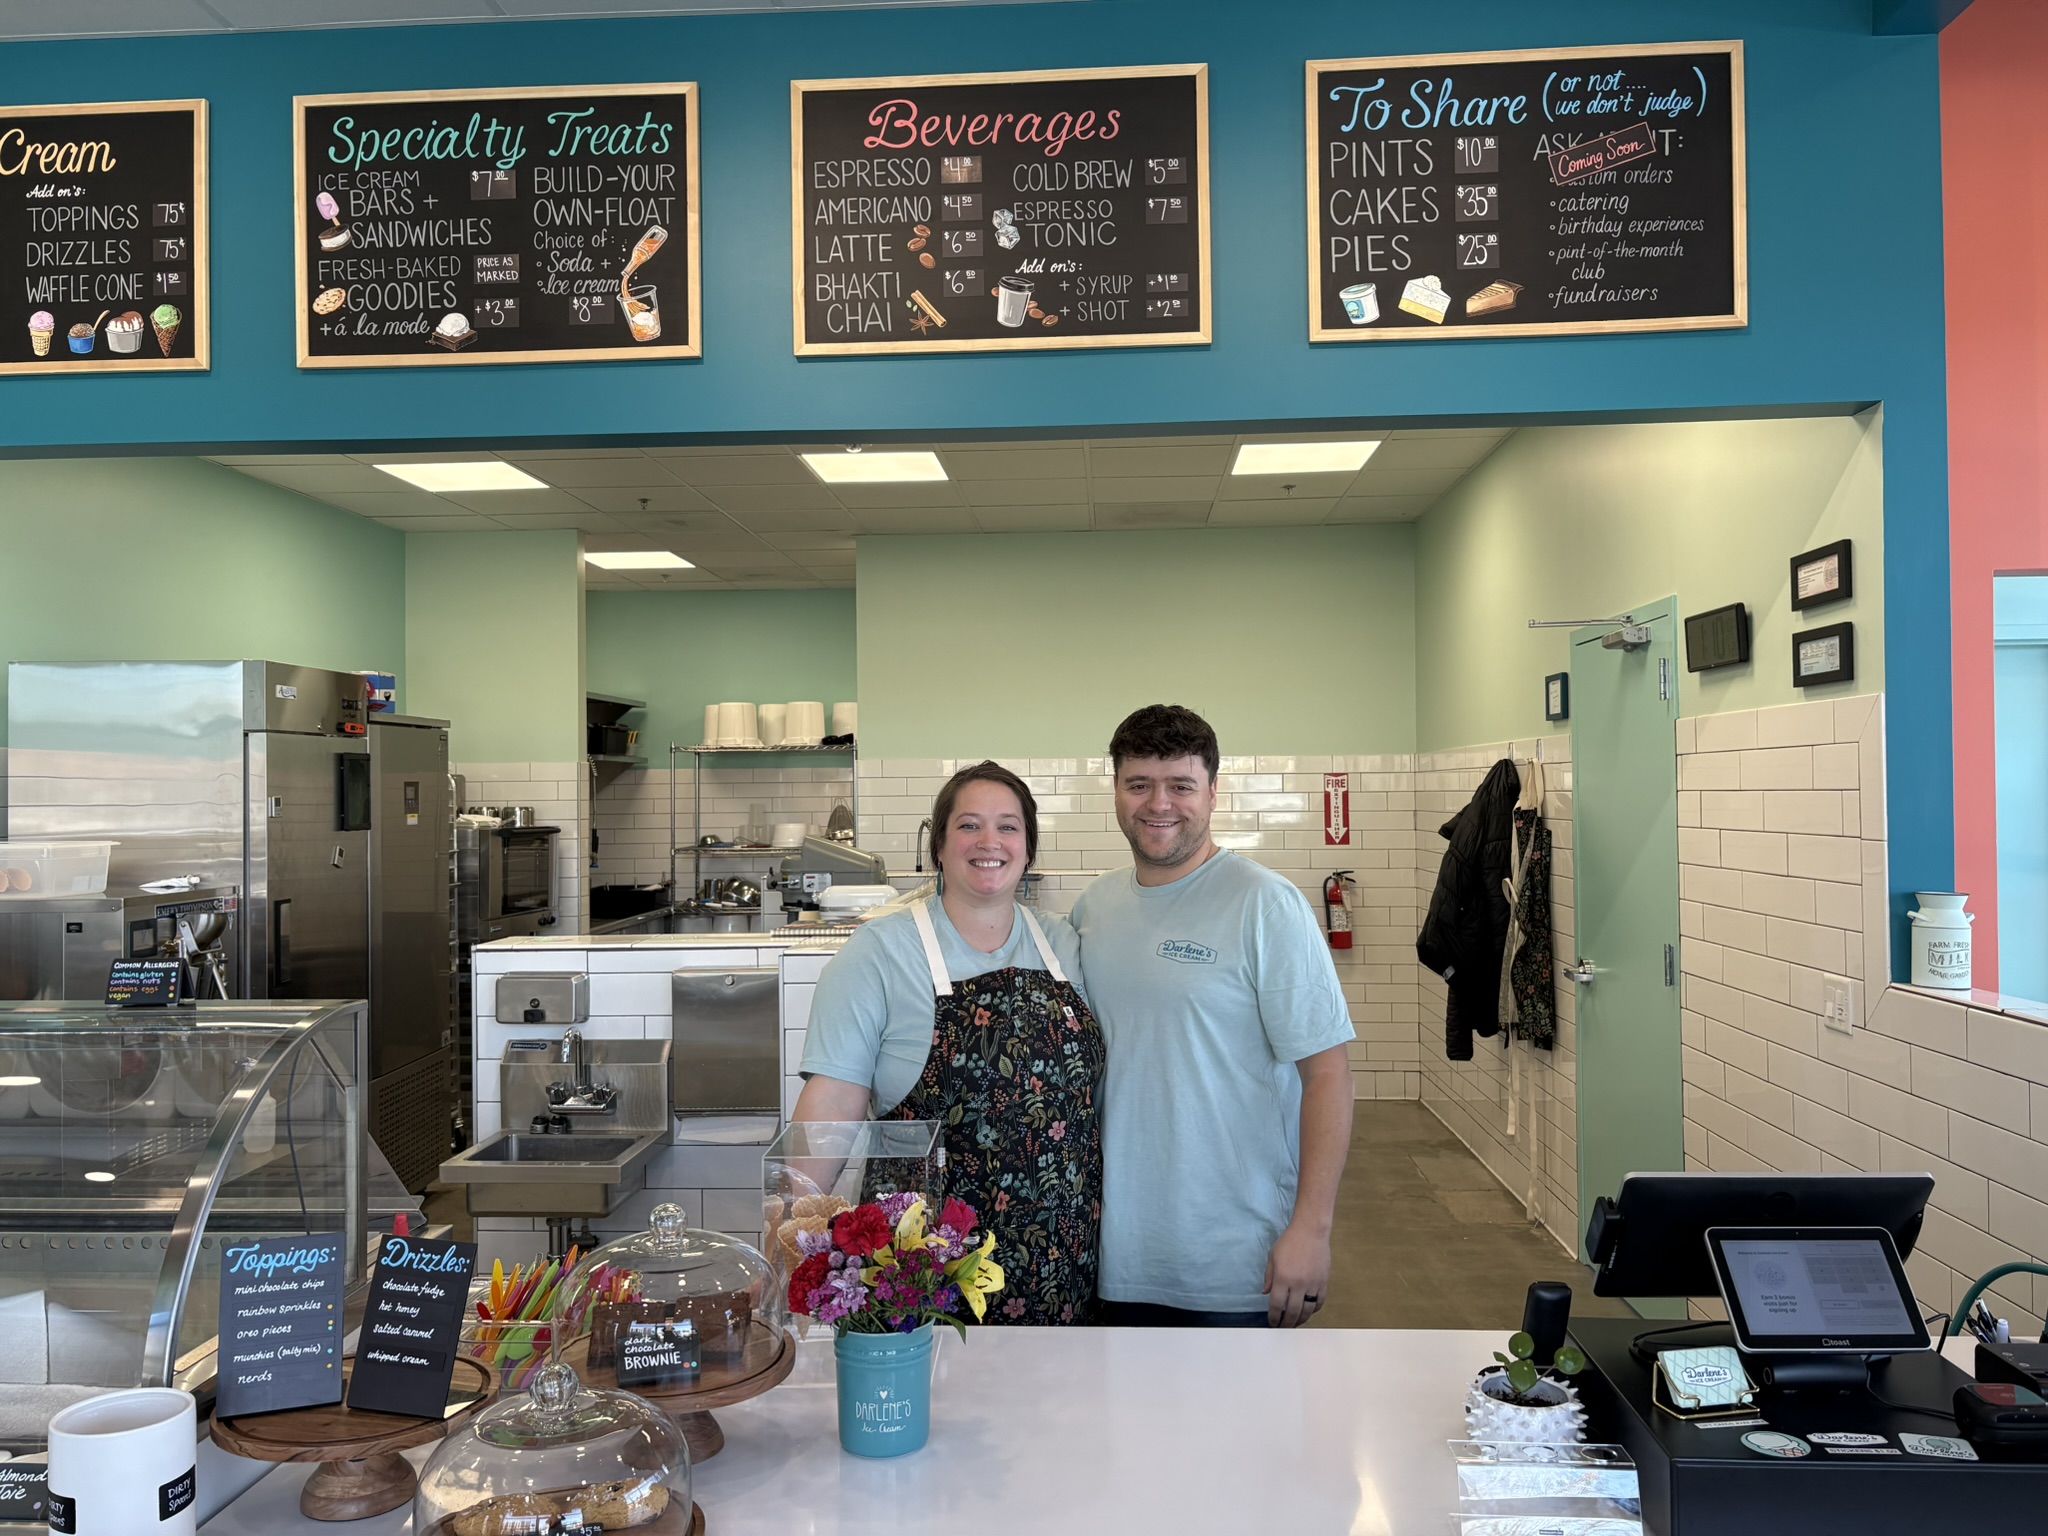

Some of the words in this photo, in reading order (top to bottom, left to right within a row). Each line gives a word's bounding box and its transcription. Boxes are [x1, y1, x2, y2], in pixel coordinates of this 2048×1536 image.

[1329, 78, 1392, 132] To
[1401, 78, 1527, 129] Share
[1555, 99, 1580, 115] we
[1586, 92, 1633, 113] don't
[328, 112, 527, 170] Specialty
[547, 107, 673, 157] Treats
[863, 99, 1121, 157] Beverages
[0, 128, 117, 176] Cream
[1330, 139, 1433, 178] PINTS
[1558, 153, 1603, 177] Coming
[1606, 138, 1645, 160] Soon
[318, 173, 349, 191] ICE
[356, 171, 420, 189] CREAM
[534, 164, 676, 194] BUILD-YOUR
[814, 158, 931, 189] ESPRESSO
[1013, 163, 1069, 192] COLD
[1075, 159, 1133, 190] BREW
[1624, 163, 1673, 183] orders
[26, 185, 54, 198] Add
[57, 185, 86, 197] on's:
[350, 188, 415, 217] BARS
[534, 197, 676, 226] OWN-FLOAT
[815, 196, 932, 225] AMERICANO
[1014, 200, 1113, 221] ESPRESSO
[1330, 186, 1439, 225] CAKES
[1558, 192, 1629, 214] catering
[26, 204, 140, 232] TOPPINGS
[1558, 217, 1622, 237] birthday
[1628, 217, 1704, 236] experiences
[352, 218, 492, 249] SANDWICHES
[534, 231, 584, 249] Choice
[592, 229, 615, 247] of:
[1025, 222, 1117, 247] TONIC
[26, 239, 131, 267] DRIZZLES
[815, 234, 892, 263] LATTE
[1331, 235, 1411, 272] PIES
[1556, 239, 1684, 265] pint-of-the-month
[318, 257, 461, 281] FRESH-BAKED
[477, 258, 500, 268] PRICE
[503, 257, 513, 266] AS
[548, 251, 594, 272] Soda
[1015, 259, 1044, 273] Add
[1050, 260, 1083, 273] on's:
[1572, 263, 1605, 280] club
[477, 271, 518, 283] MARKED
[541, 275, 570, 294] Ice
[574, 278, 620, 293] cream
[816, 272, 900, 301] BHAKTI
[1076, 275, 1133, 295] SYRUP
[25, 274, 90, 303] WAFFLE
[95, 273, 144, 300] CONE
[347, 281, 457, 312] GOODIES
[1553, 283, 1658, 308] fundraisers
[827, 302, 892, 333] CHAI
[1077, 300, 1129, 321] SHOT
[353, 313, 379, 336] la
[382, 312, 430, 335] mode
[1327, 779, 1345, 788] FIRE
[1163, 940, 1211, 957] Darlene's
[1931, 952, 1968, 965] MILK
[226, 1243, 336, 1278] Toppings:
[381, 1238, 470, 1272] Drizzles:
[235, 1286, 257, 1295] mini
[258, 1282, 299, 1292] chocolate
[302, 1278, 325, 1289] chips
[383, 1278, 419, 1292] chocolate
[418, 1281, 445, 1298] fudge
[237, 1306, 277, 1317] rainbow
[279, 1300, 322, 1314] sprinkles
[379, 1300, 392, 1311] hot
[396, 1300, 420, 1317] honey
[237, 1329, 258, 1339] oreo
[262, 1324, 292, 1337] pieces
[373, 1323, 400, 1335] salted
[403, 1328, 434, 1338] caramel
[625, 1335, 653, 1346] dark
[233, 1350, 274, 1362] munchies
[368, 1351, 400, 1362] whipped
[402, 1356, 429, 1365] cream
[625, 1342, 675, 1354] chocolate
[624, 1351, 681, 1370] BROWNIE
[238, 1370, 272, 1384] nerds
[1685, 1367, 1727, 1378] Darlene's
[856, 1399, 911, 1421] DARLENE'S
[862, 1423, 876, 1432] Ice
[879, 1424, 906, 1433] Cream
[0, 1469, 48, 1481] Almond
[168, 1477, 191, 1498] DIRTY
